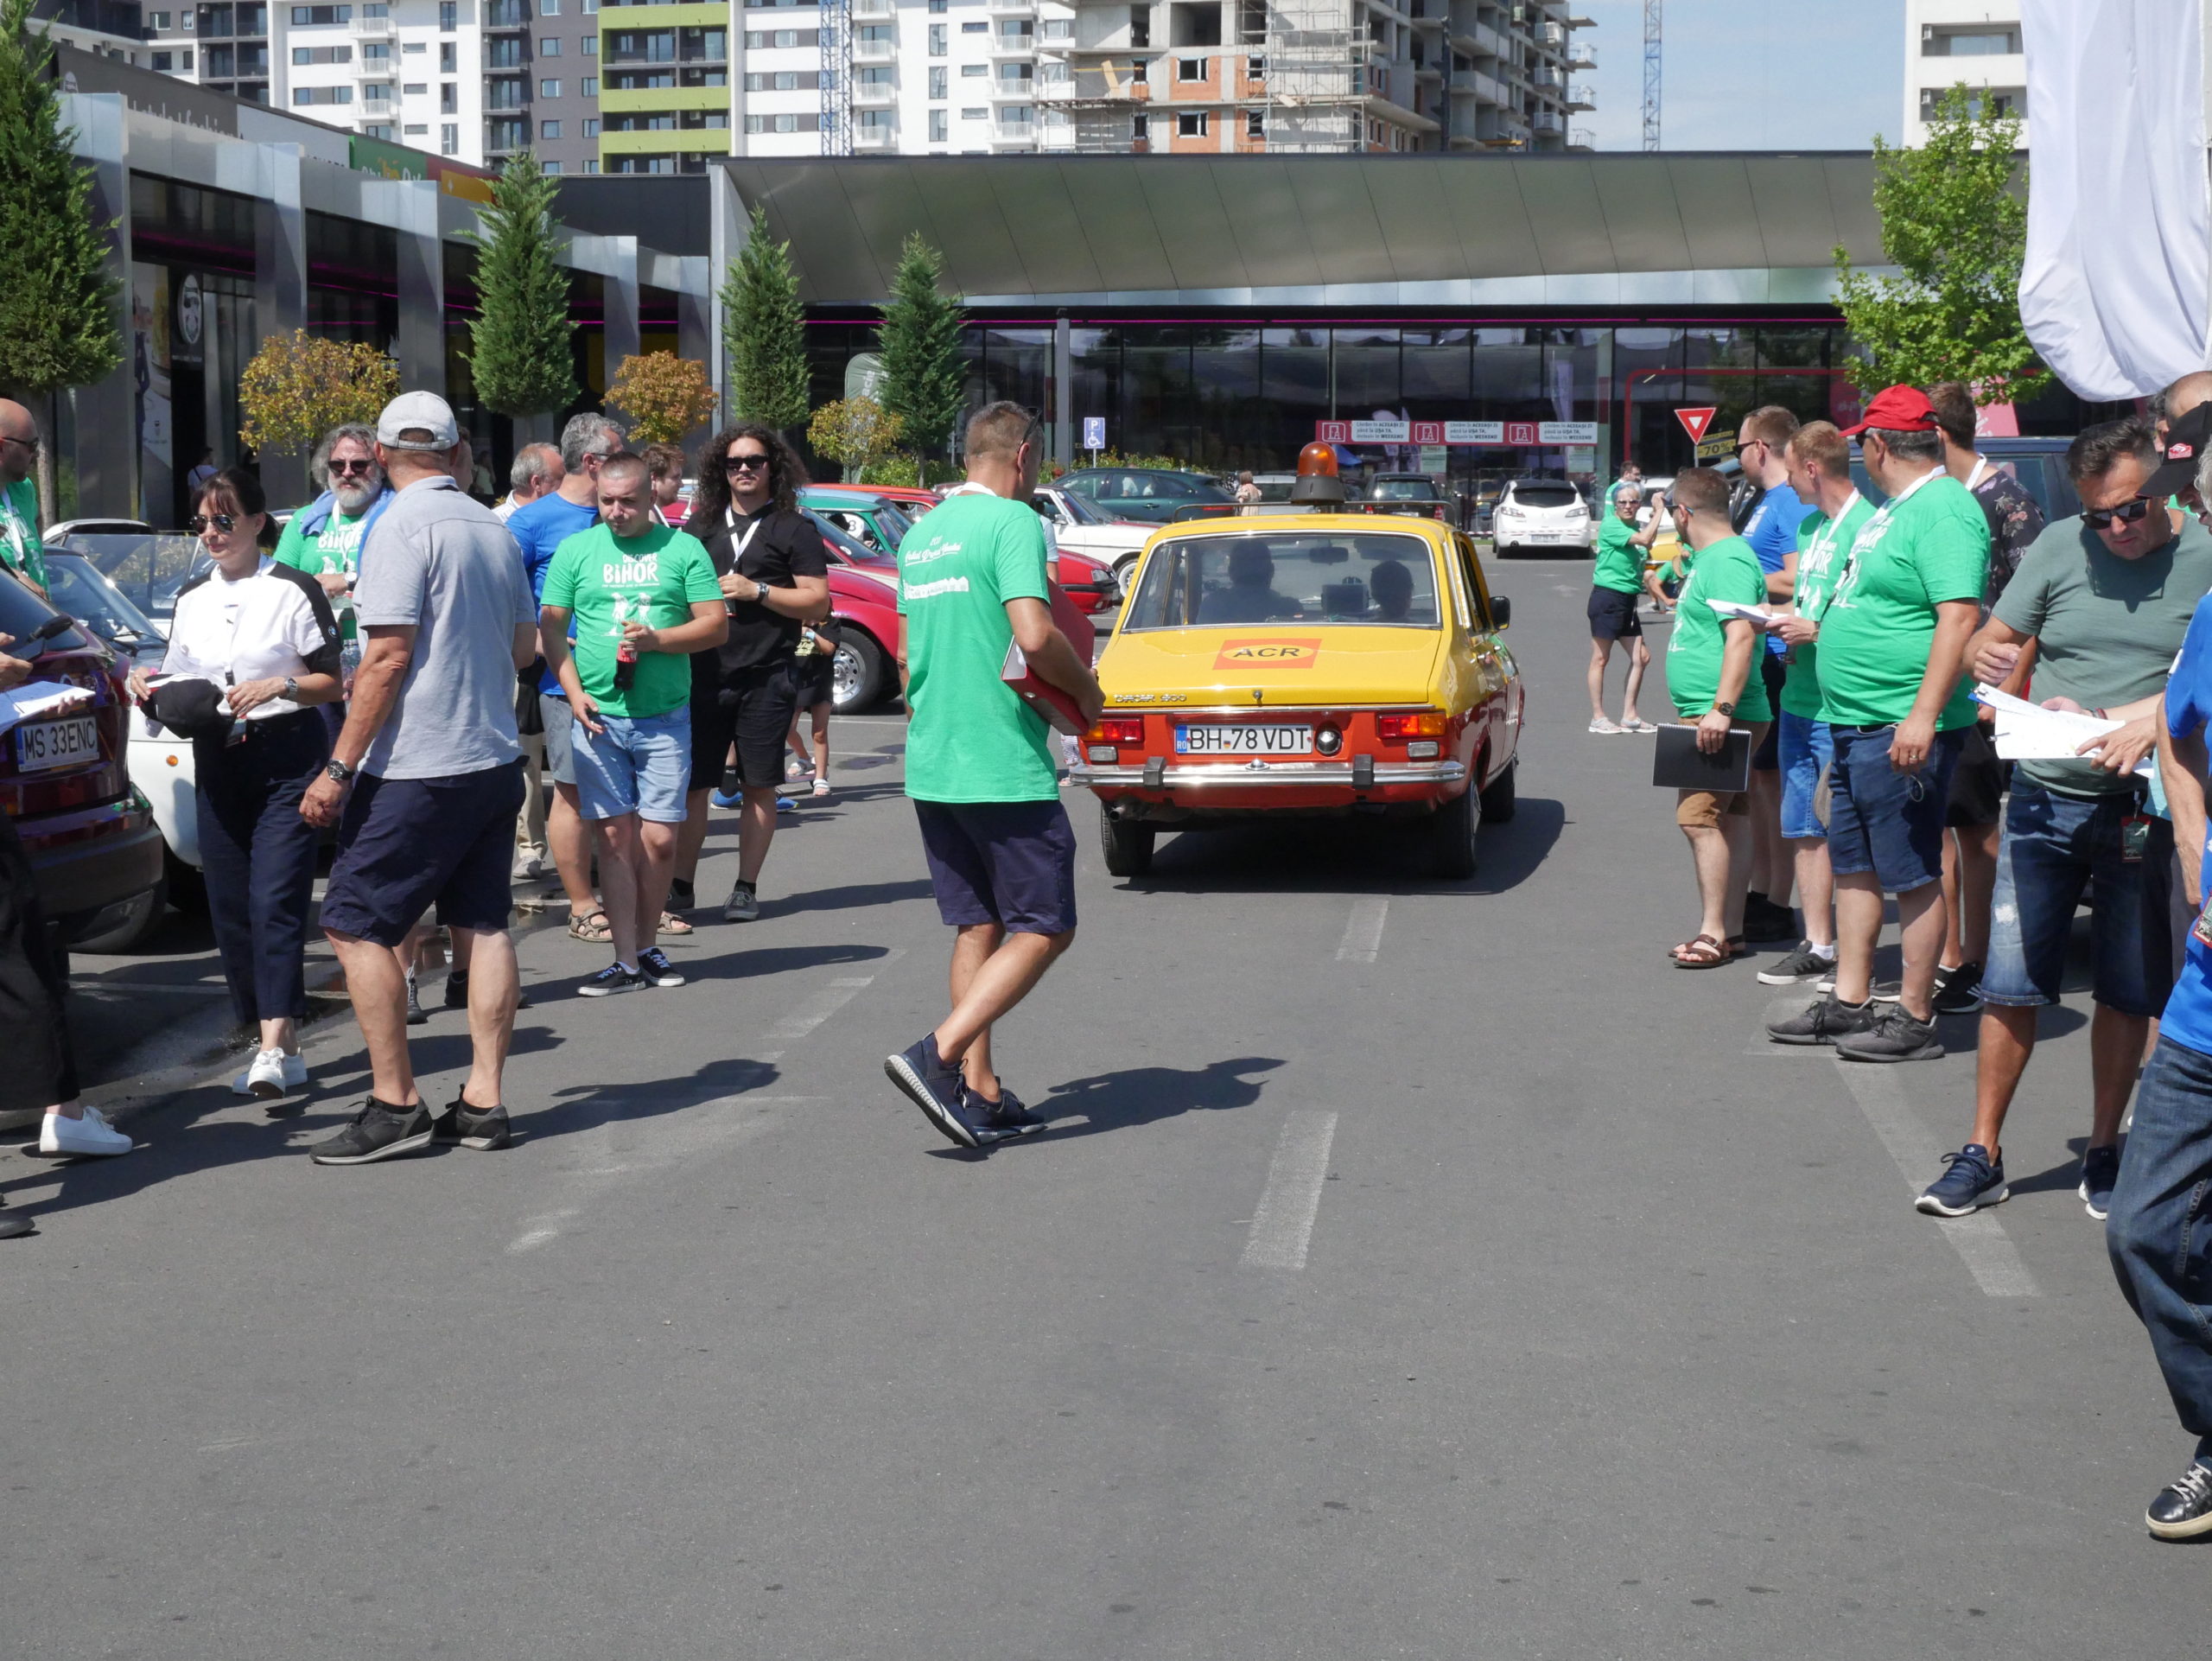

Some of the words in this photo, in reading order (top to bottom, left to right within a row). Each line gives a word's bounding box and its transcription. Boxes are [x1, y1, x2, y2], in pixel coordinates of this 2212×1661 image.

[1090, 420, 1098, 430] P
[1233, 647, 1300, 658] ACR
[23, 729, 46, 760] MS
[1190, 728, 1222, 750] BH
[1177, 741, 1187, 749] RO
